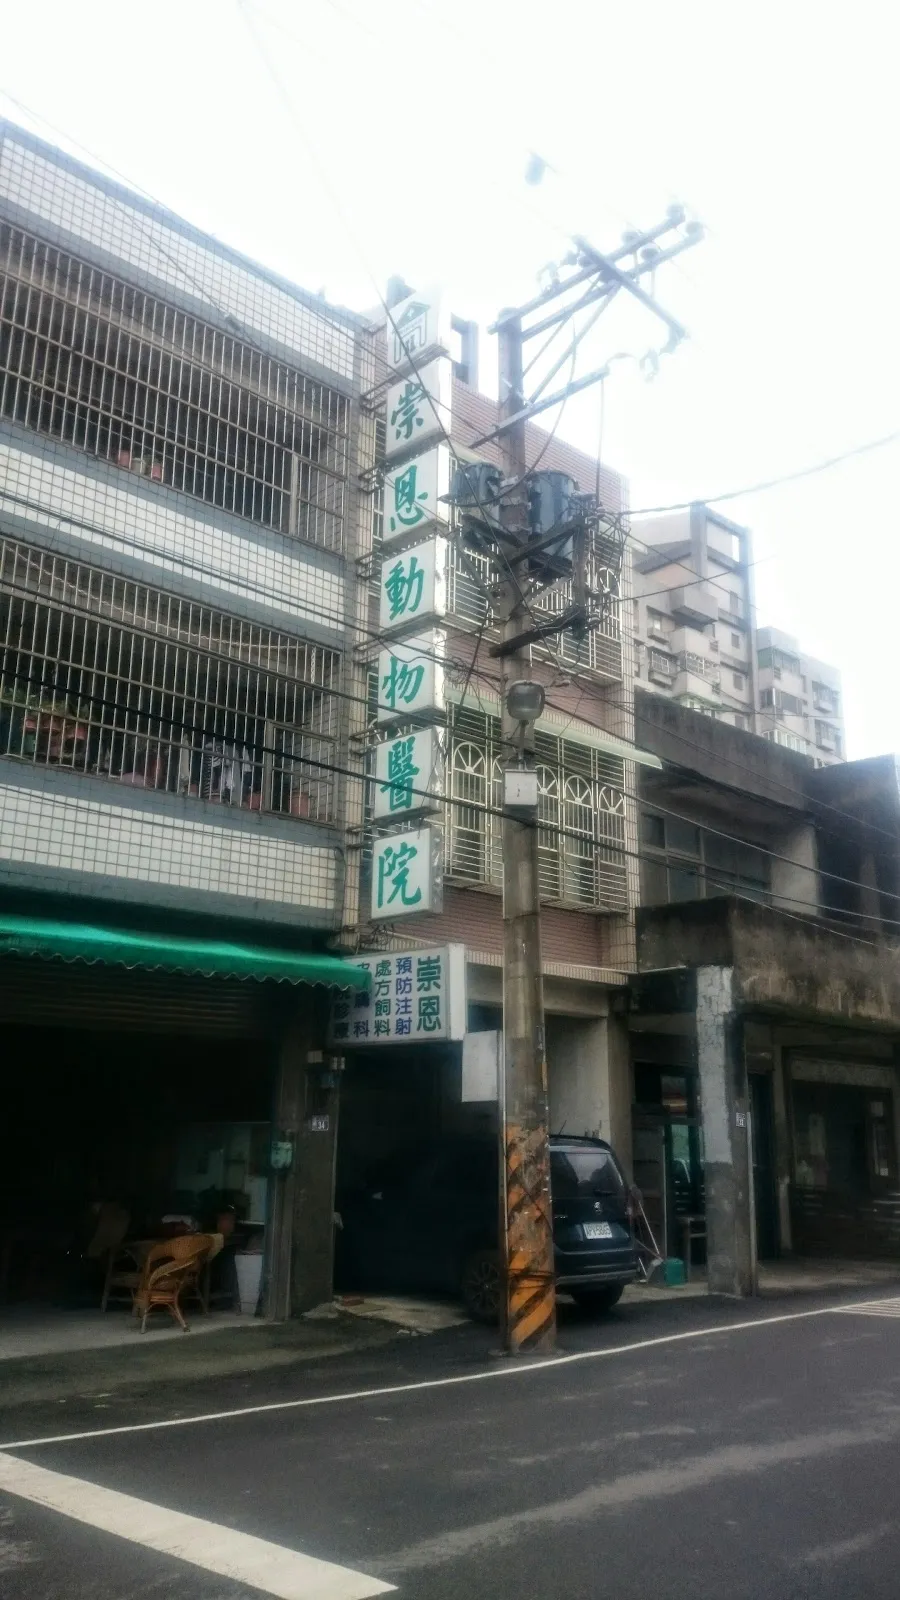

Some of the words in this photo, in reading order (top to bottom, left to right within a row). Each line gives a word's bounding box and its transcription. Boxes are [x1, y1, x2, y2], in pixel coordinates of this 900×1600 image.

[377, 382, 429, 909] 崇恩動物醫院
[374, 958, 392, 1038] 處方飼料
[395, 955, 413, 1036] 預防注射
[416, 954, 442, 1032] 崇恩
